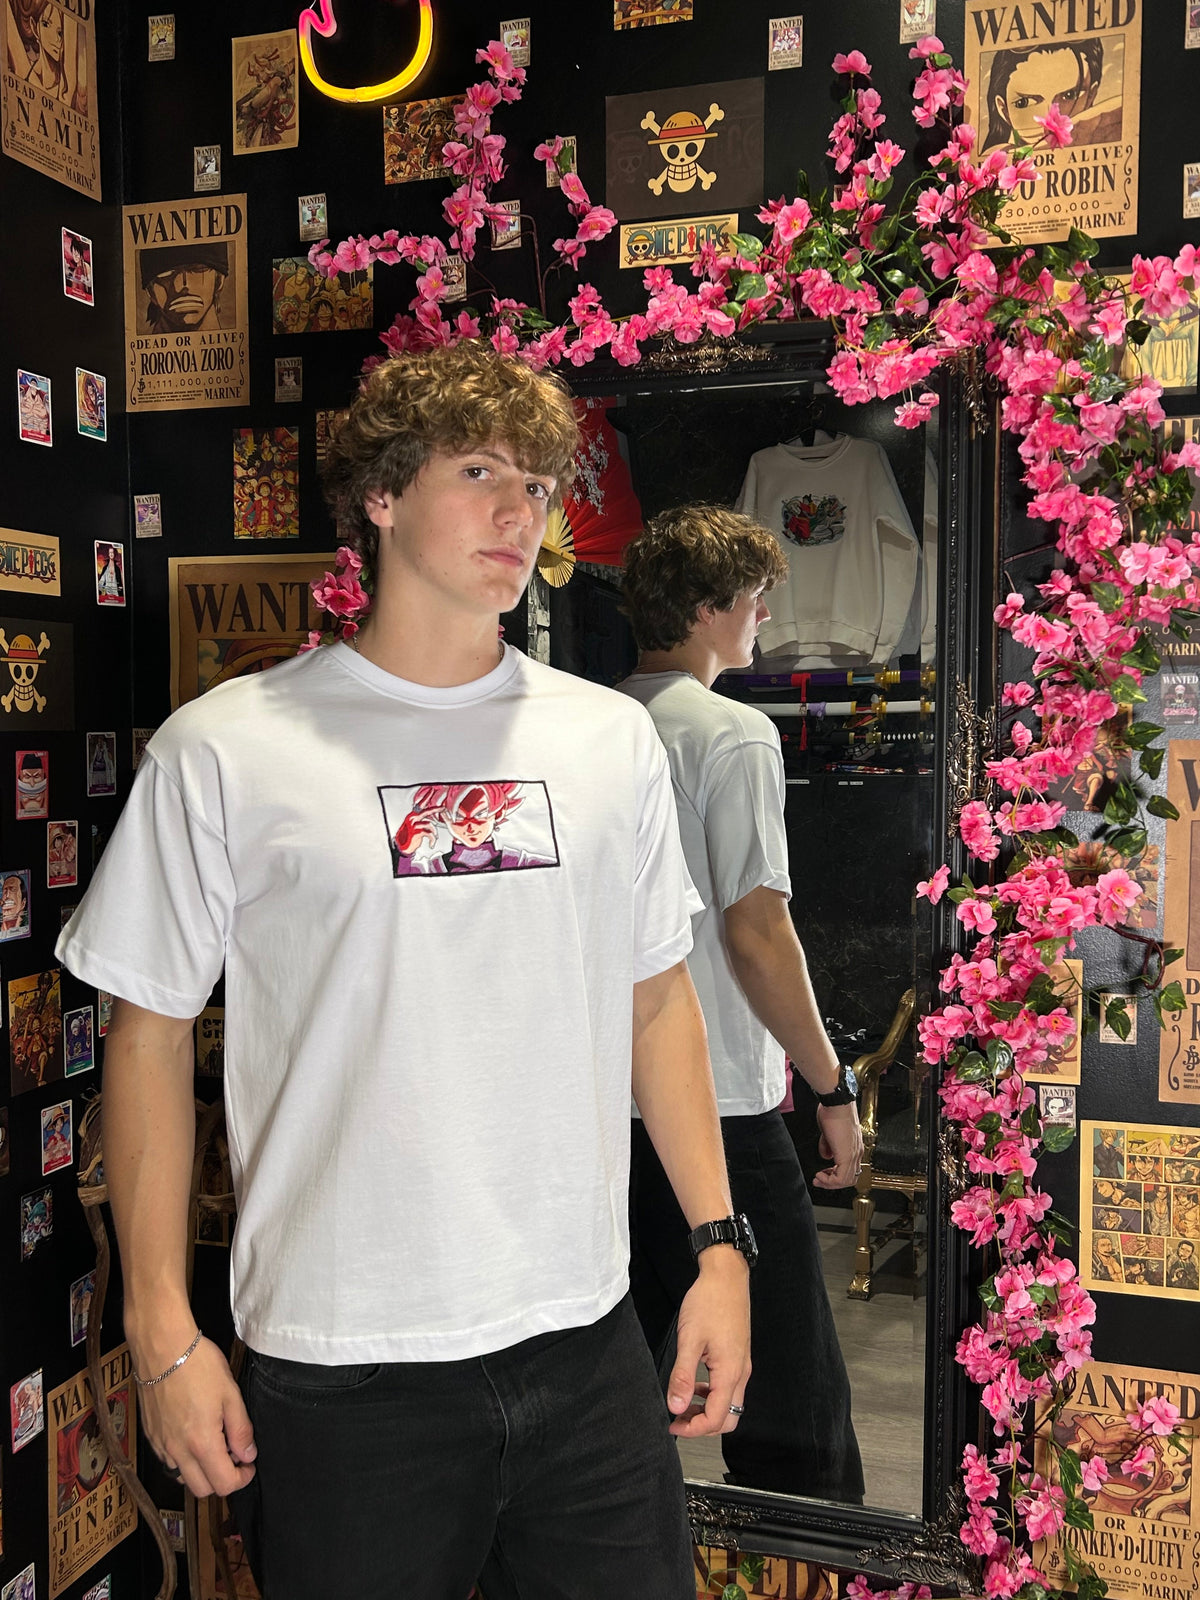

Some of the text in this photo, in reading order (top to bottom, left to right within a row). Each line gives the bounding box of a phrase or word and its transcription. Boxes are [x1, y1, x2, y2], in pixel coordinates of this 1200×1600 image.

[501, 20, 530, 31] WANTED
[771, 19, 802, 29] WANTED
[970, 0, 1136, 46] WANTED
[8, 77, 90, 133] DEAD OR ALIVE
[17, 96, 83, 157] NAMI
[195, 148, 220, 156] WANTED
[1034, 153, 1056, 168] OR
[1068, 145, 1123, 164] ALIVE
[65, 167, 95, 192] MARINE
[1046, 163, 1118, 199] ROBIN
[300, 195, 326, 206] WANTED
[127, 204, 242, 245] WANTED
[1073, 211, 1126, 231] MARINE
[136, 332, 238, 350] DEAD OR ALIVE
[141, 346, 234, 376] RORONOA ZORO
[204, 386, 243, 400] MARINE
[136, 496, 160, 504] WANTED
[1162, 675, 1199, 685] WANTED
[1041, 1087, 1074, 1097] WANTED
[58, 1506, 81, 1532] DEAD
[86, 1492, 98, 1508] OR
[60, 1484, 128, 1556] JINBE
[106, 1514, 132, 1542] MARINE
[1104, 1516, 1192, 1541] OR ALIVE
[1142, 1583, 1194, 1600] MARINE
